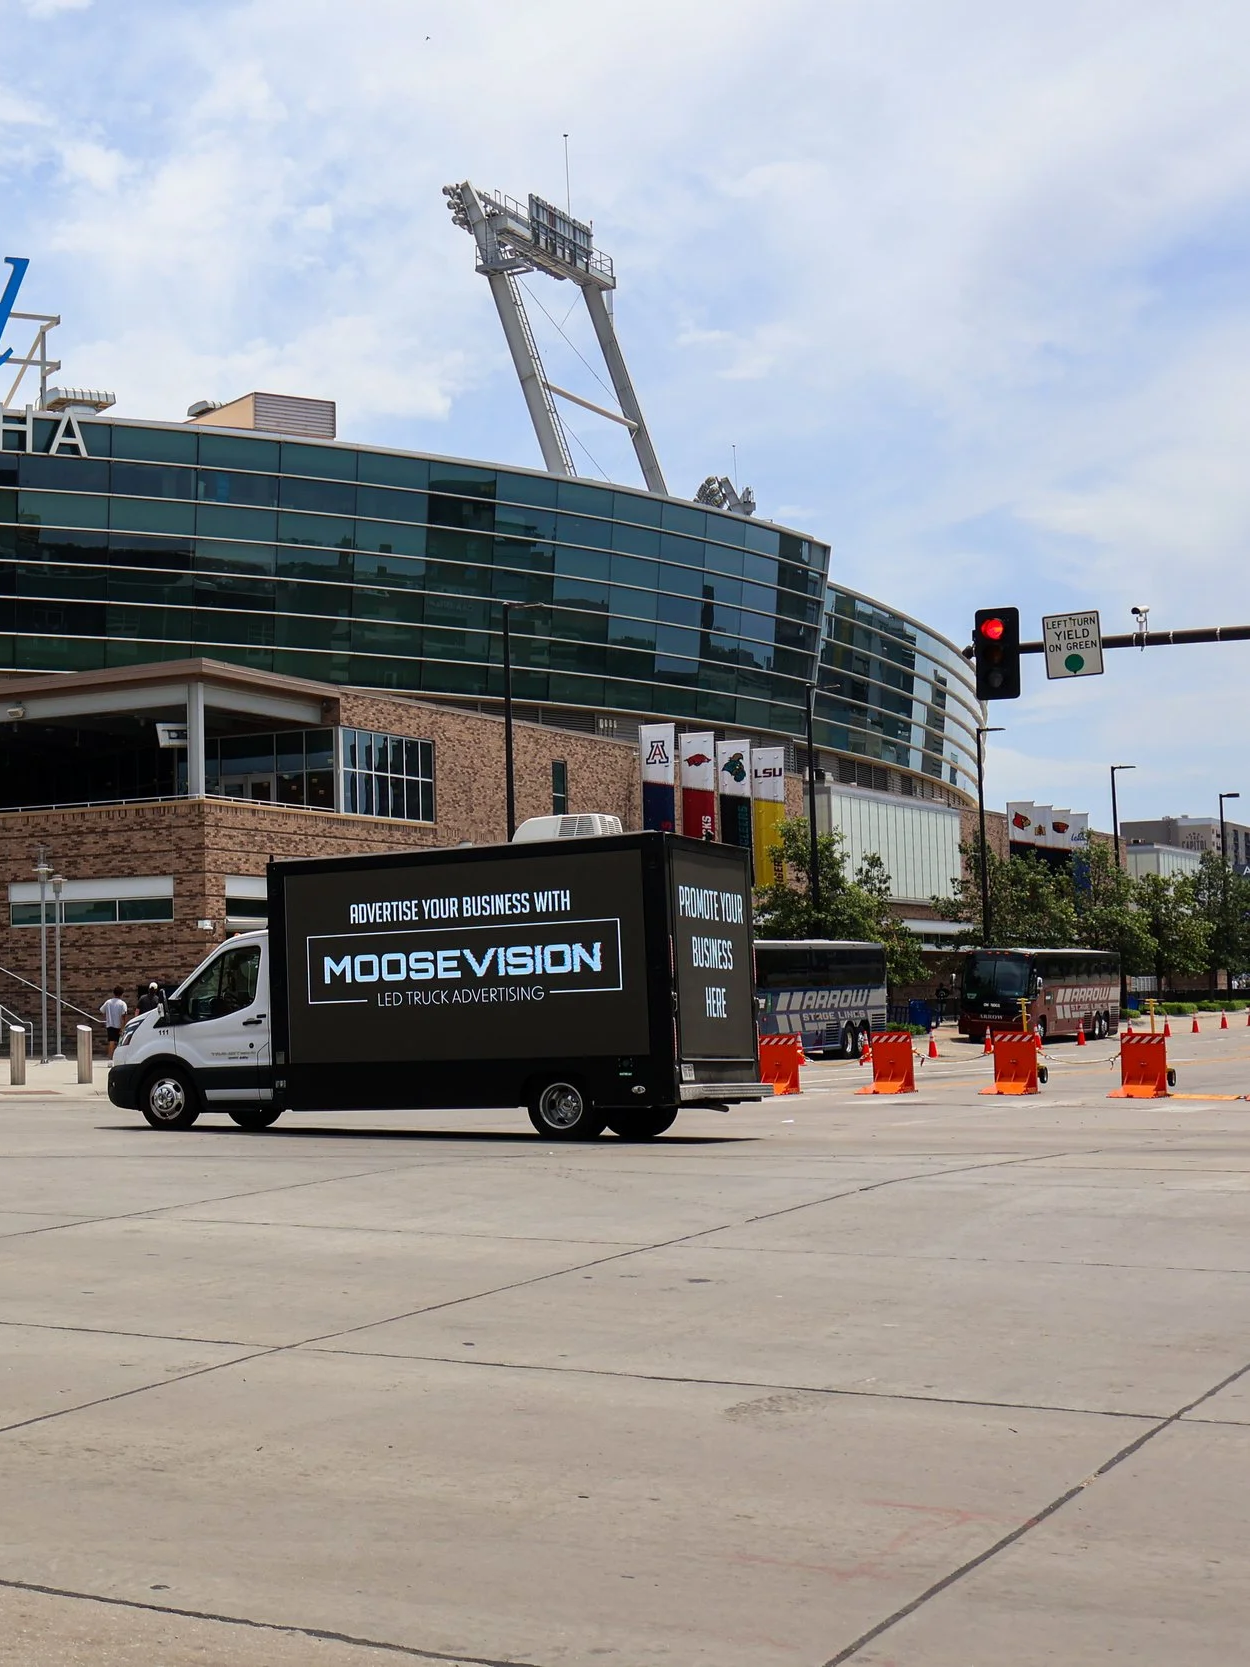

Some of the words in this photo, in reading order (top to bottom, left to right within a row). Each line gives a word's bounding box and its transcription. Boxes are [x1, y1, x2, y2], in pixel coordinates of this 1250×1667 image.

[1046, 620, 1067, 629] LEFT
[1072, 617, 1095, 626] TURN
[1054, 629, 1089, 640] YIELD
[1066, 640, 1097, 651] GREEN
[754, 767, 782, 779] LSU
[350, 902, 419, 924] ADVERTISE
[422, 897, 458, 920] YOUR
[463, 893, 530, 917] BUSINESS
[533, 889, 571, 912] WITH
[678, 885, 719, 919] PROMOTE
[719, 894, 744, 924] YOUR
[323, 942, 602, 984] MOOSEVISION
[692, 936, 733, 970] BUSINESS
[377, 992, 403, 1007] LED
[406, 990, 449, 1006] TRUCK
[452, 985, 545, 1004] ADVERTISING
[705, 987, 727, 1018] HERE
[802, 989, 869, 1010] ARROW
[1070, 987, 1111, 1002] ARROW
